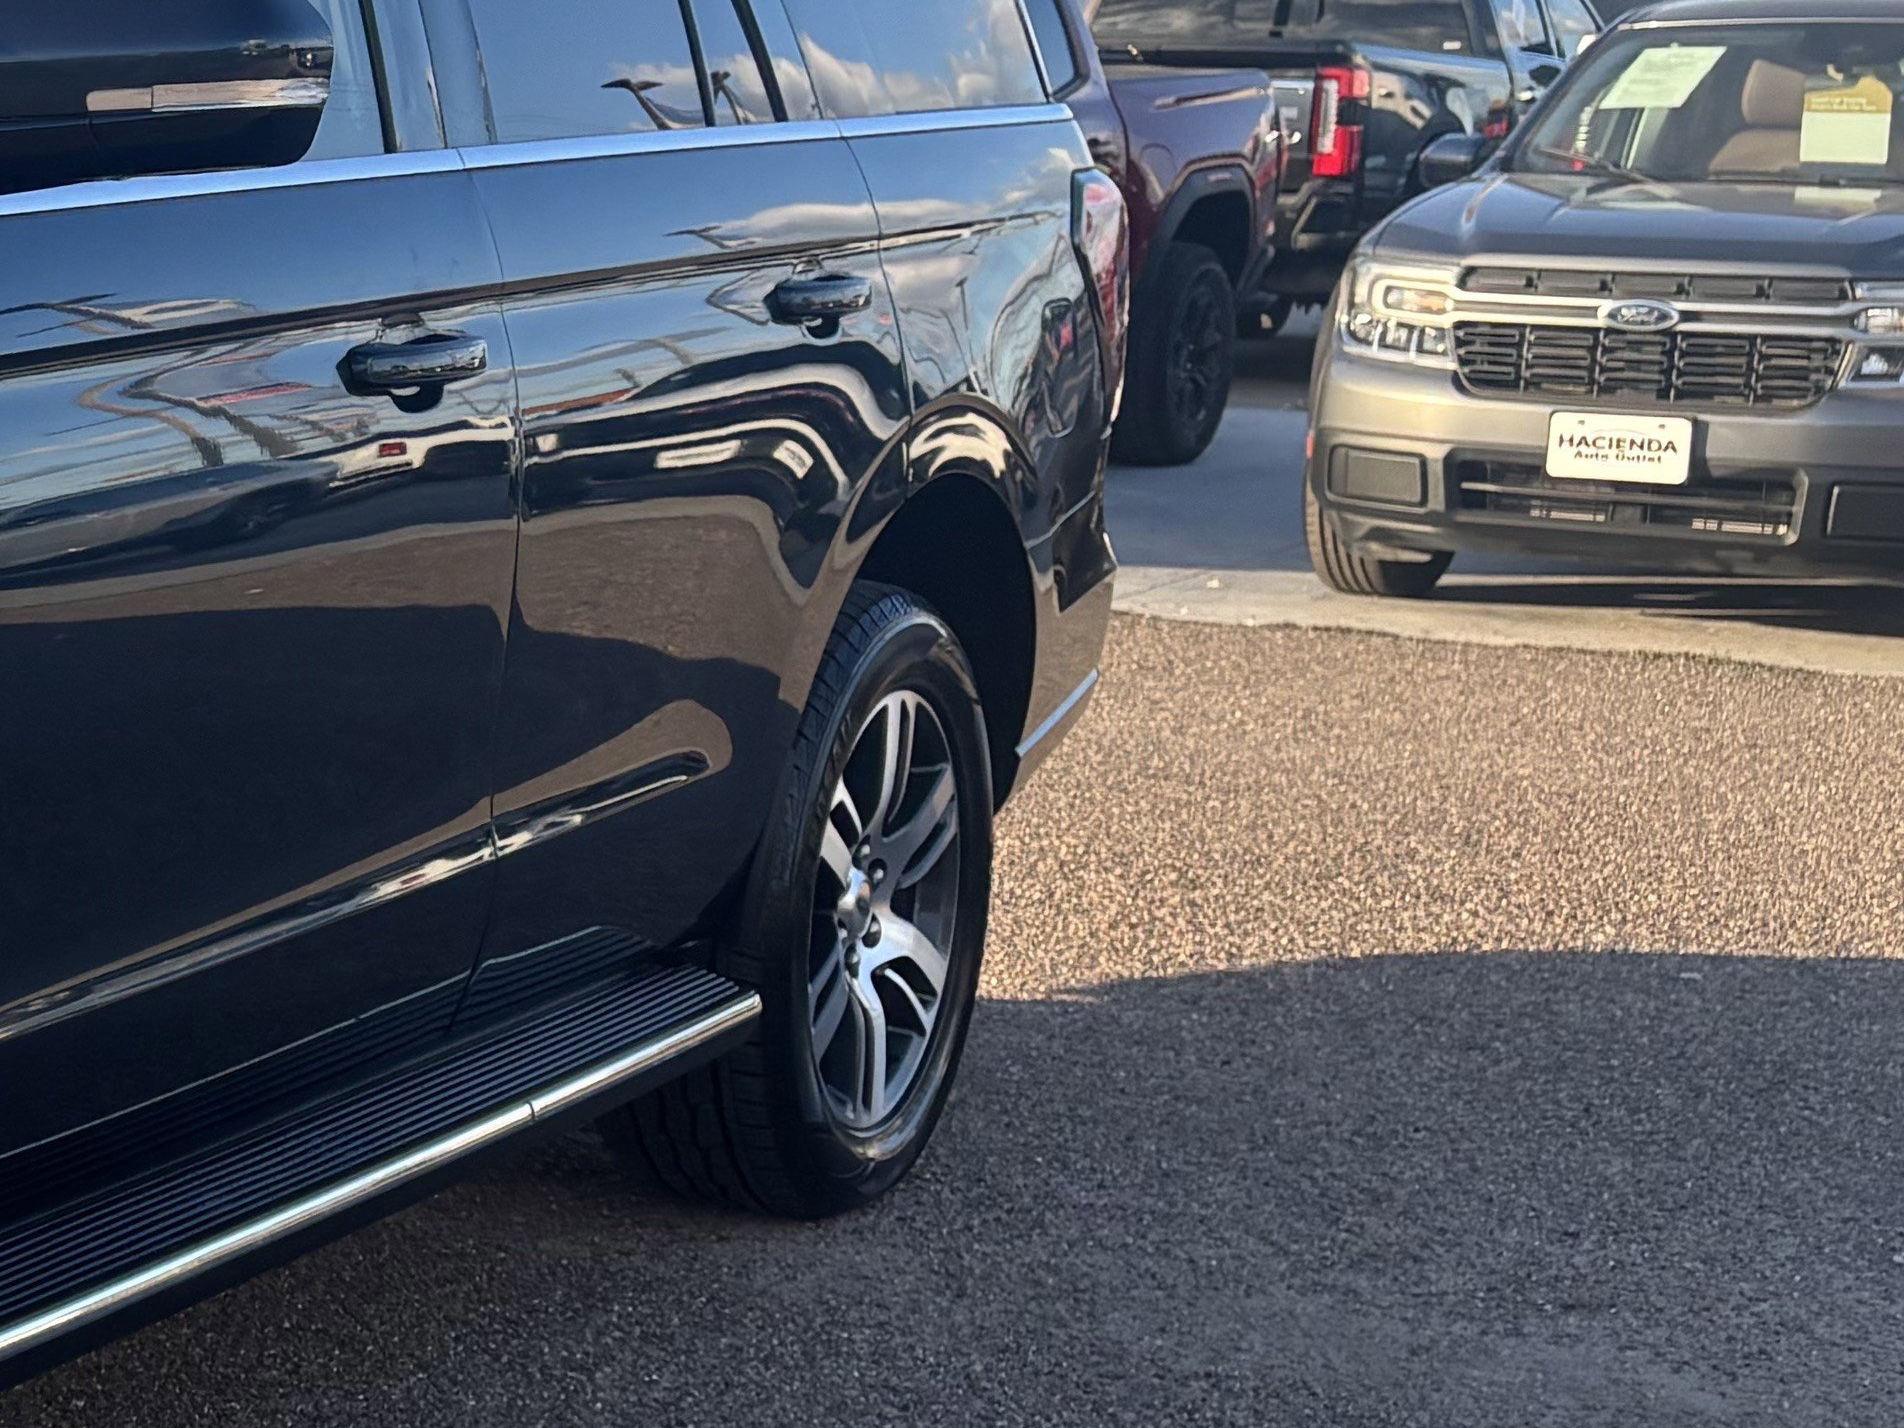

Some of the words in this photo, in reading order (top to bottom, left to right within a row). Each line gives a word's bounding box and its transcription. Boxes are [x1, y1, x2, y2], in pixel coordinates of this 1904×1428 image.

[1558, 434, 1678, 454] HACIENDA
[1574, 450, 1609, 462] Auto
[1615, 452, 1662, 464] Outlet
